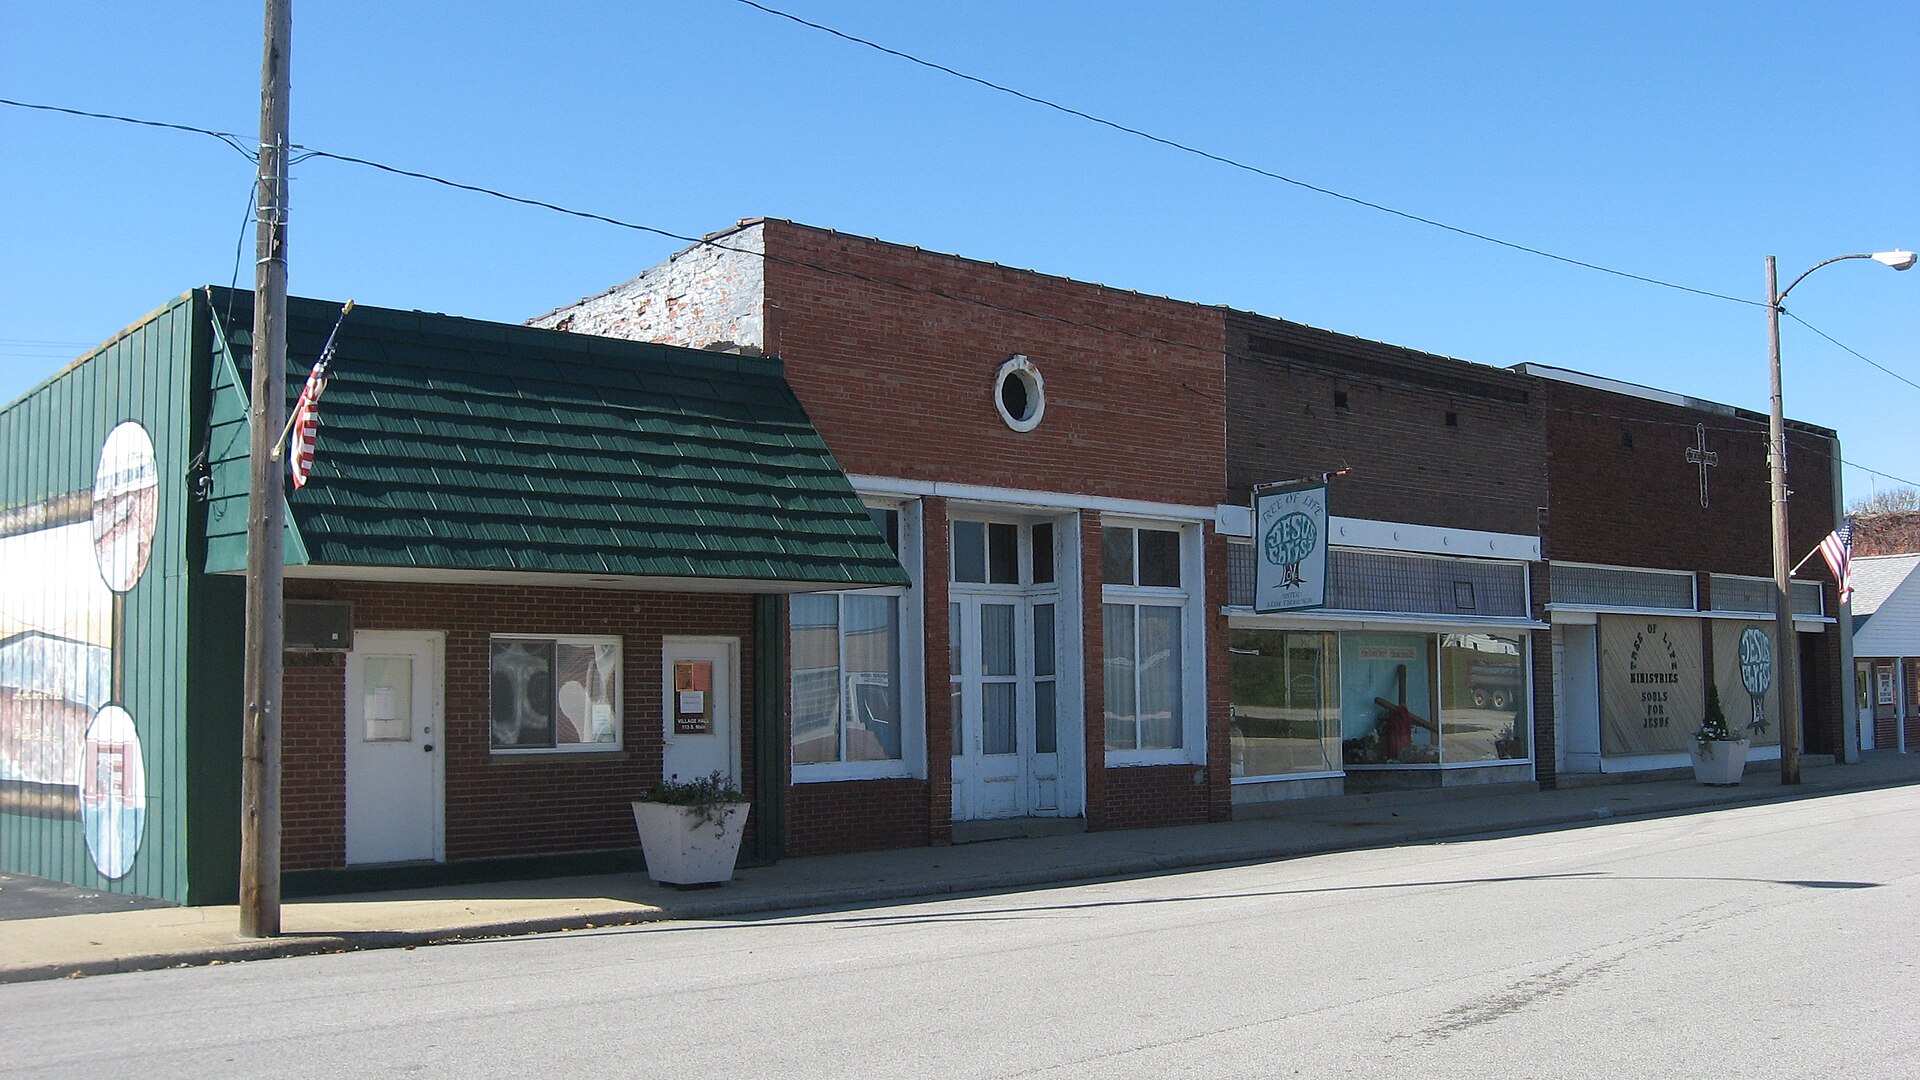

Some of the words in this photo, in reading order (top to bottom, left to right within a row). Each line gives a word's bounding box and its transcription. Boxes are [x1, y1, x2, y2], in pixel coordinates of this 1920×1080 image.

[1262, 498, 1281, 523] TREE
[1285, 493, 1299, 503] OF
[1302, 496, 1323, 517] LIFE
[1268, 515, 1316, 547] JESUS
[1647, 624, 1657, 633] OF
[1630, 673, 1678, 684] MINISTRIES
[1641, 692, 1668, 701] SOULS
[1647, 705, 1664, 715] FOR
[1643, 717, 1669, 728] JESUS
